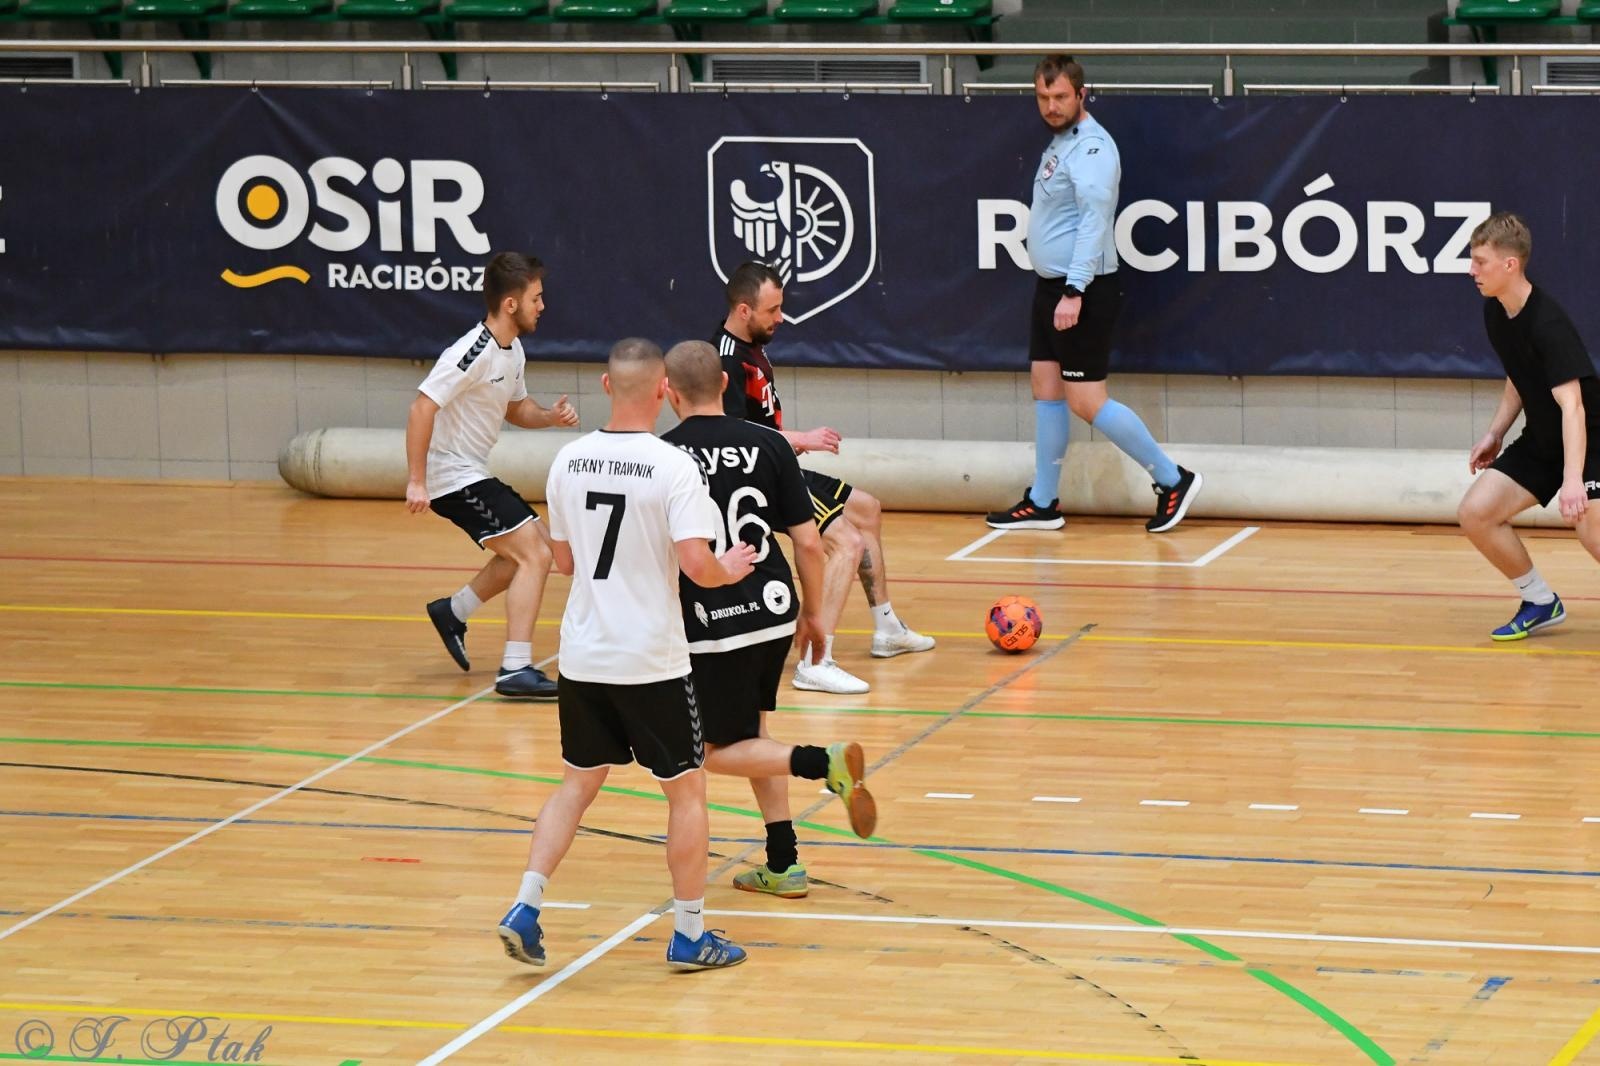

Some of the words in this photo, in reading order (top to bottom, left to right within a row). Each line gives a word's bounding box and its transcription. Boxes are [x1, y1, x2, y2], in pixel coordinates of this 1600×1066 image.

[215, 154, 492, 255] OSiR
[977, 172, 1492, 274] RCIBÓRZ
[327, 257, 486, 292] RACIBÓRZ
[568, 458, 604, 476] PIĘKNY
[608, 460, 655, 479] TRAWNIK
[585, 490, 626, 580] 7
[710, 601, 761, 621] DRUKOL.PL
[1004, 623, 1029, 647] SELECT
